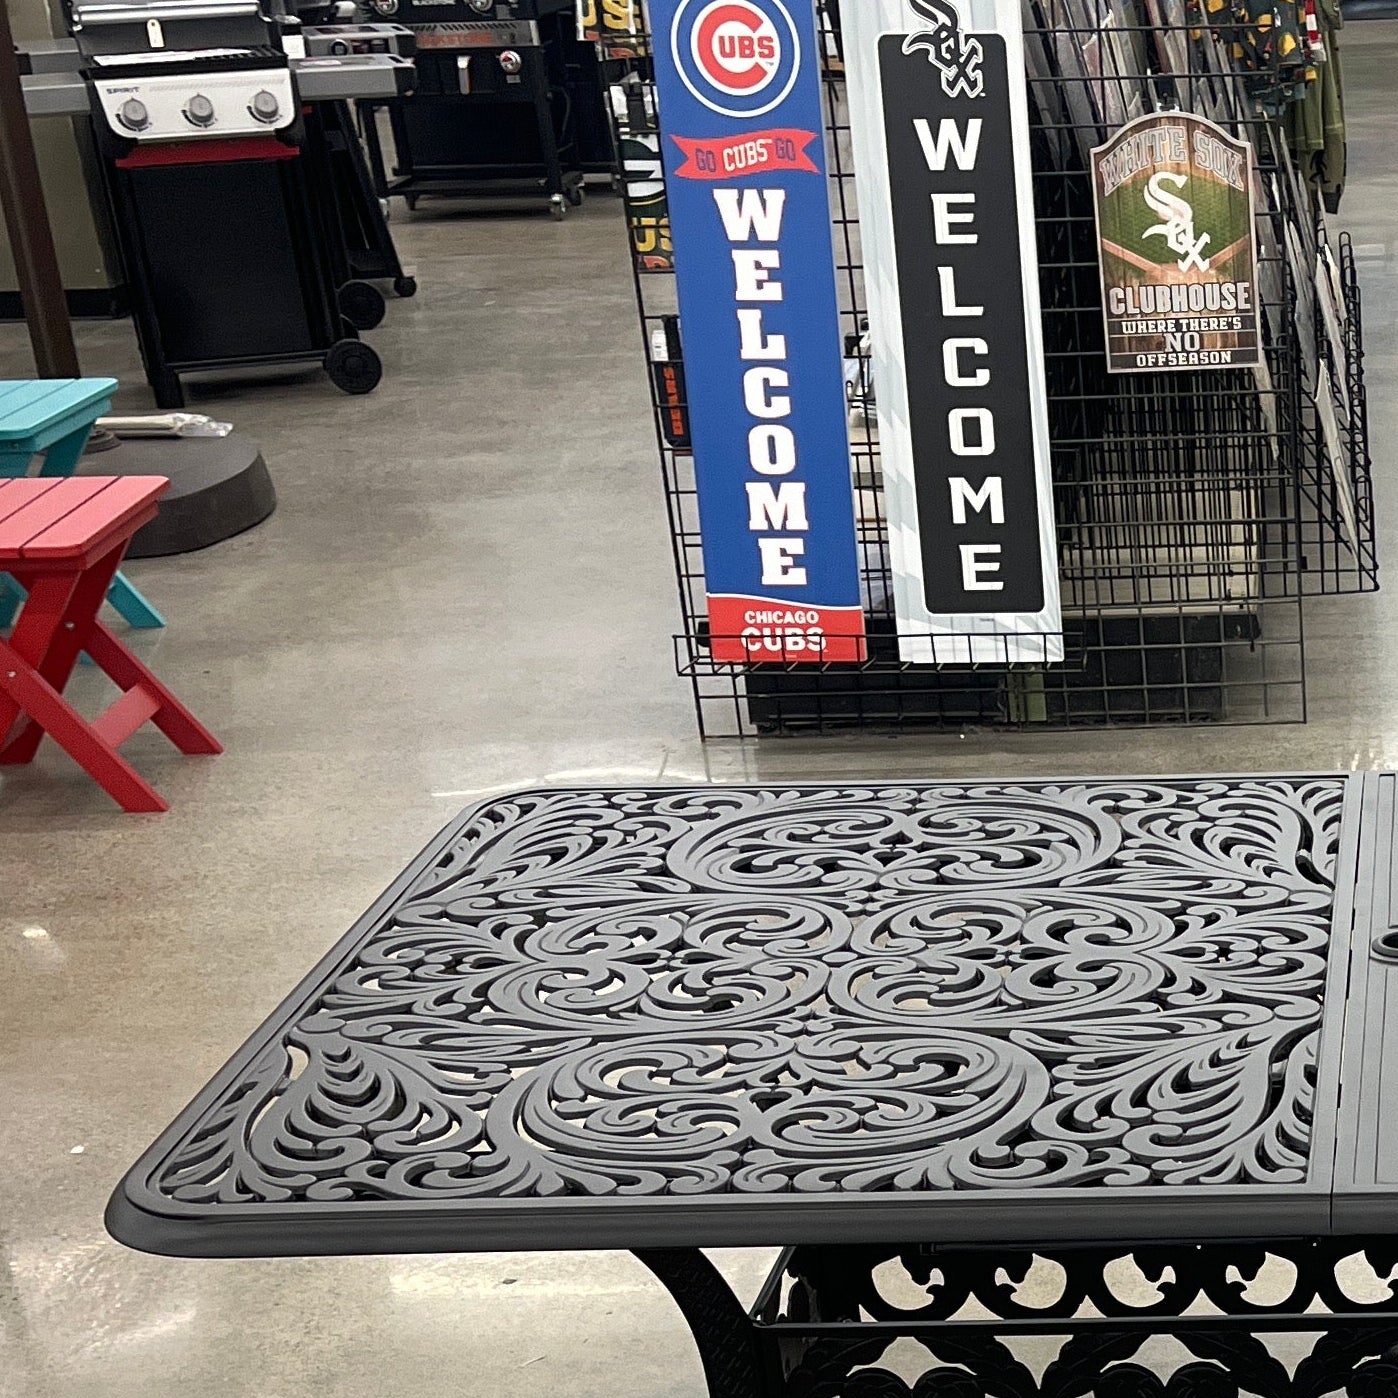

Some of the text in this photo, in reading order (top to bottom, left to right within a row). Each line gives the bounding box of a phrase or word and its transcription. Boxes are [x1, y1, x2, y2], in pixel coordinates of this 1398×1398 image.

[695, 138, 796, 172] GO CUBS GO
[1099, 125, 1245, 197] WHITE SOX
[1108, 281, 1251, 315] CLUBHOUSE
[1122, 317, 1242, 334] WHERE THERE'S
[912, 117, 1005, 592] WELCOME
[1163, 331, 1201, 352] NO
[1136, 351, 1232, 367] OFFSEASON
[712, 188, 808, 586] WELCOME
[744, 610, 820, 625] CHICAGO
[740, 626, 827, 652] CUBS
